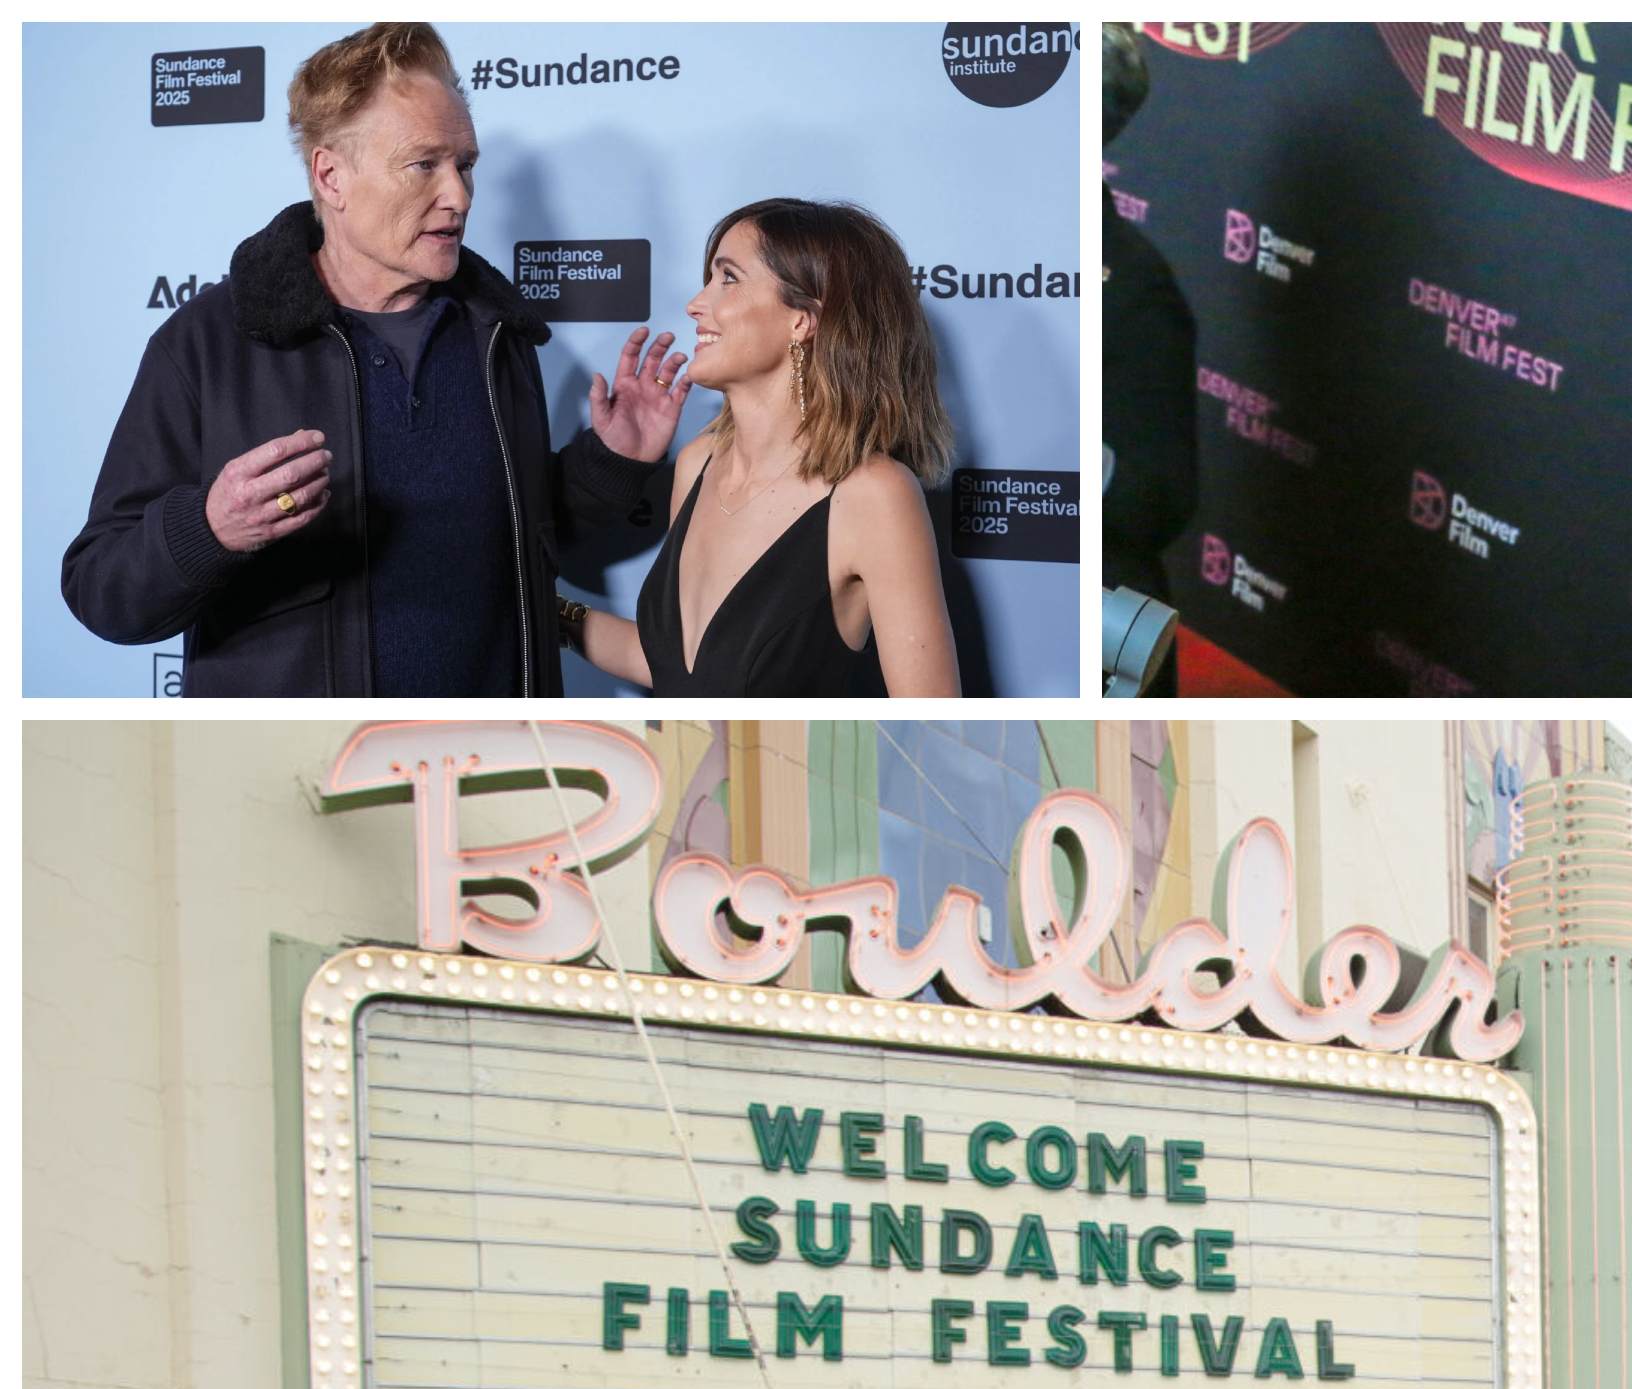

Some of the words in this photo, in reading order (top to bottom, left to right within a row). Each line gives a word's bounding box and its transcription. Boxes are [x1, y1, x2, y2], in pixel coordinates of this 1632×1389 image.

[155, 56, 226, 73] Sundance
[156, 74, 185, 89] Film
[187, 69, 241, 88] Festival
[471, 52, 681, 90] #Sundance
[949, 59, 1017, 76] institute
[155, 90, 191, 106] 2025
[1422, 35, 1595, 161] FILM
[519, 247, 603, 263] Sundance
[519, 265, 554, 281] Film
[557, 264, 622, 280] Festival
[519, 284, 560, 299] 2025
[1409, 278, 1499, 336] DENVER
[1446, 322, 1499, 365] FILM
[1502, 345, 1563, 391] FEST
[960, 475, 1061, 496] Sundance
[960, 496, 1000, 513] Film
[1451, 493, 1520, 545] Denver
[960, 516, 1008, 534] 2025
[1449, 519, 1489, 559] Film
[325, 720, 1527, 1065] Boulder
[748, 1102, 1206, 1202] WELCOME
[730, 1195, 1237, 1291] SUNDANCE
[602, 1282, 843, 1360] FILM
[930, 1298, 1355, 1380] FESTIVAL
